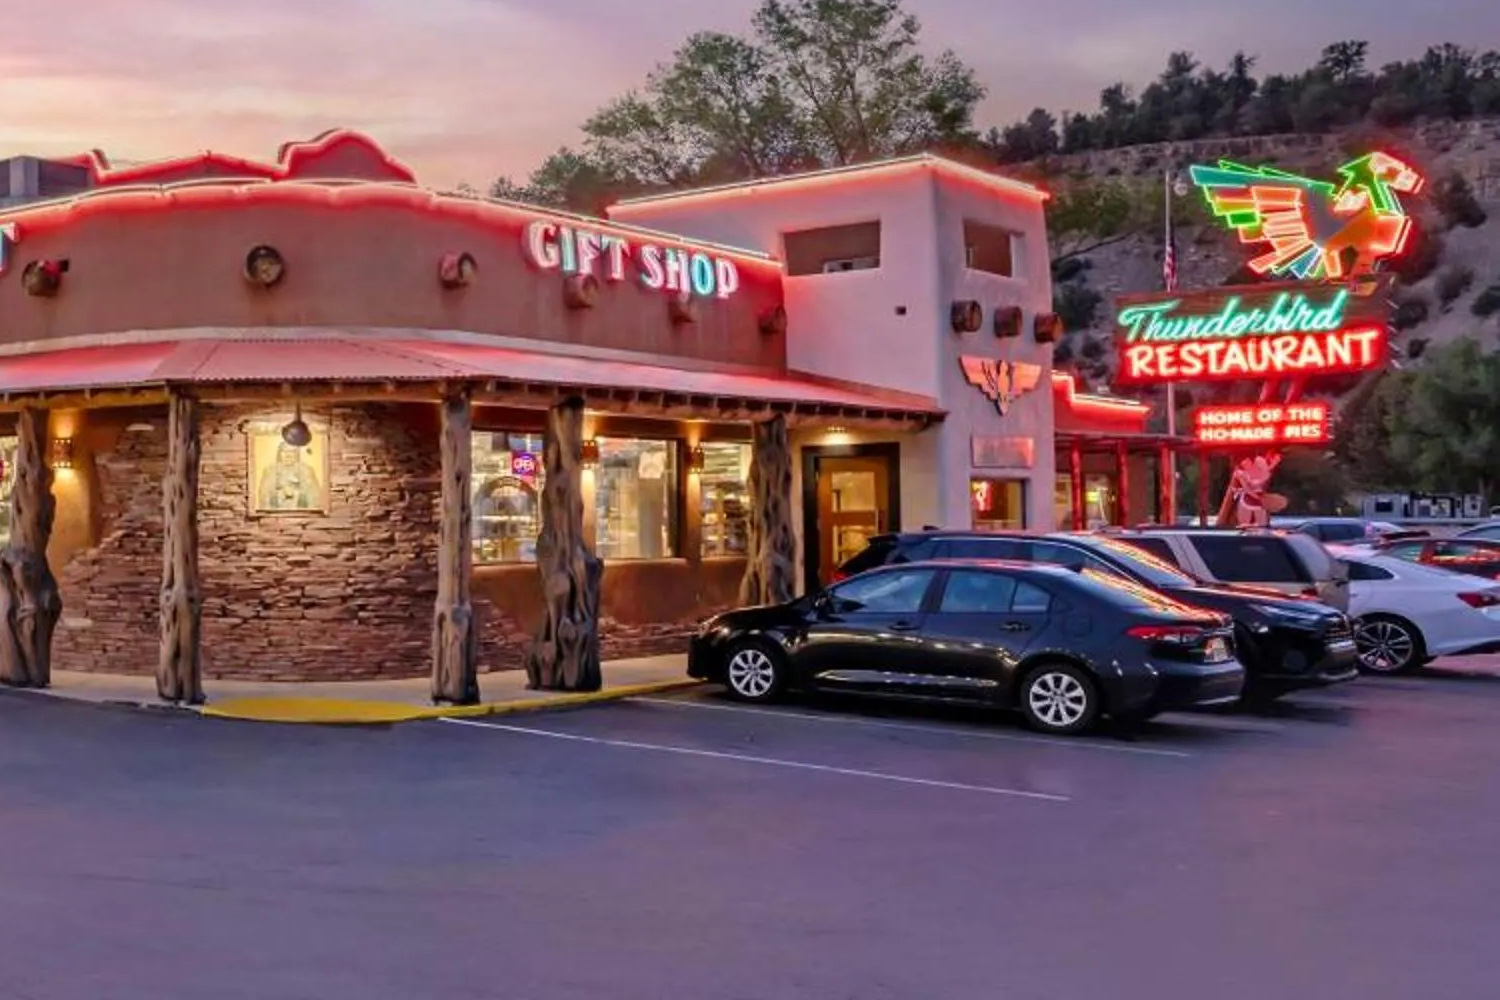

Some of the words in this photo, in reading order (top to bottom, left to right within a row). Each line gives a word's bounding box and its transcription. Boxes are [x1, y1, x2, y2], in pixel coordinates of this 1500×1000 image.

[526, 220, 630, 281] GIFT
[640, 244, 739, 302] SHOP
[1117, 288, 1349, 344] Thunderbird
[1125, 329, 1380, 378] RESTAURANT
[1199, 410, 1254, 426] HOME
[1257, 407, 1282, 423] OF
[1287, 406, 1323, 422] THE
[1284, 424, 1321, 439] PIES
